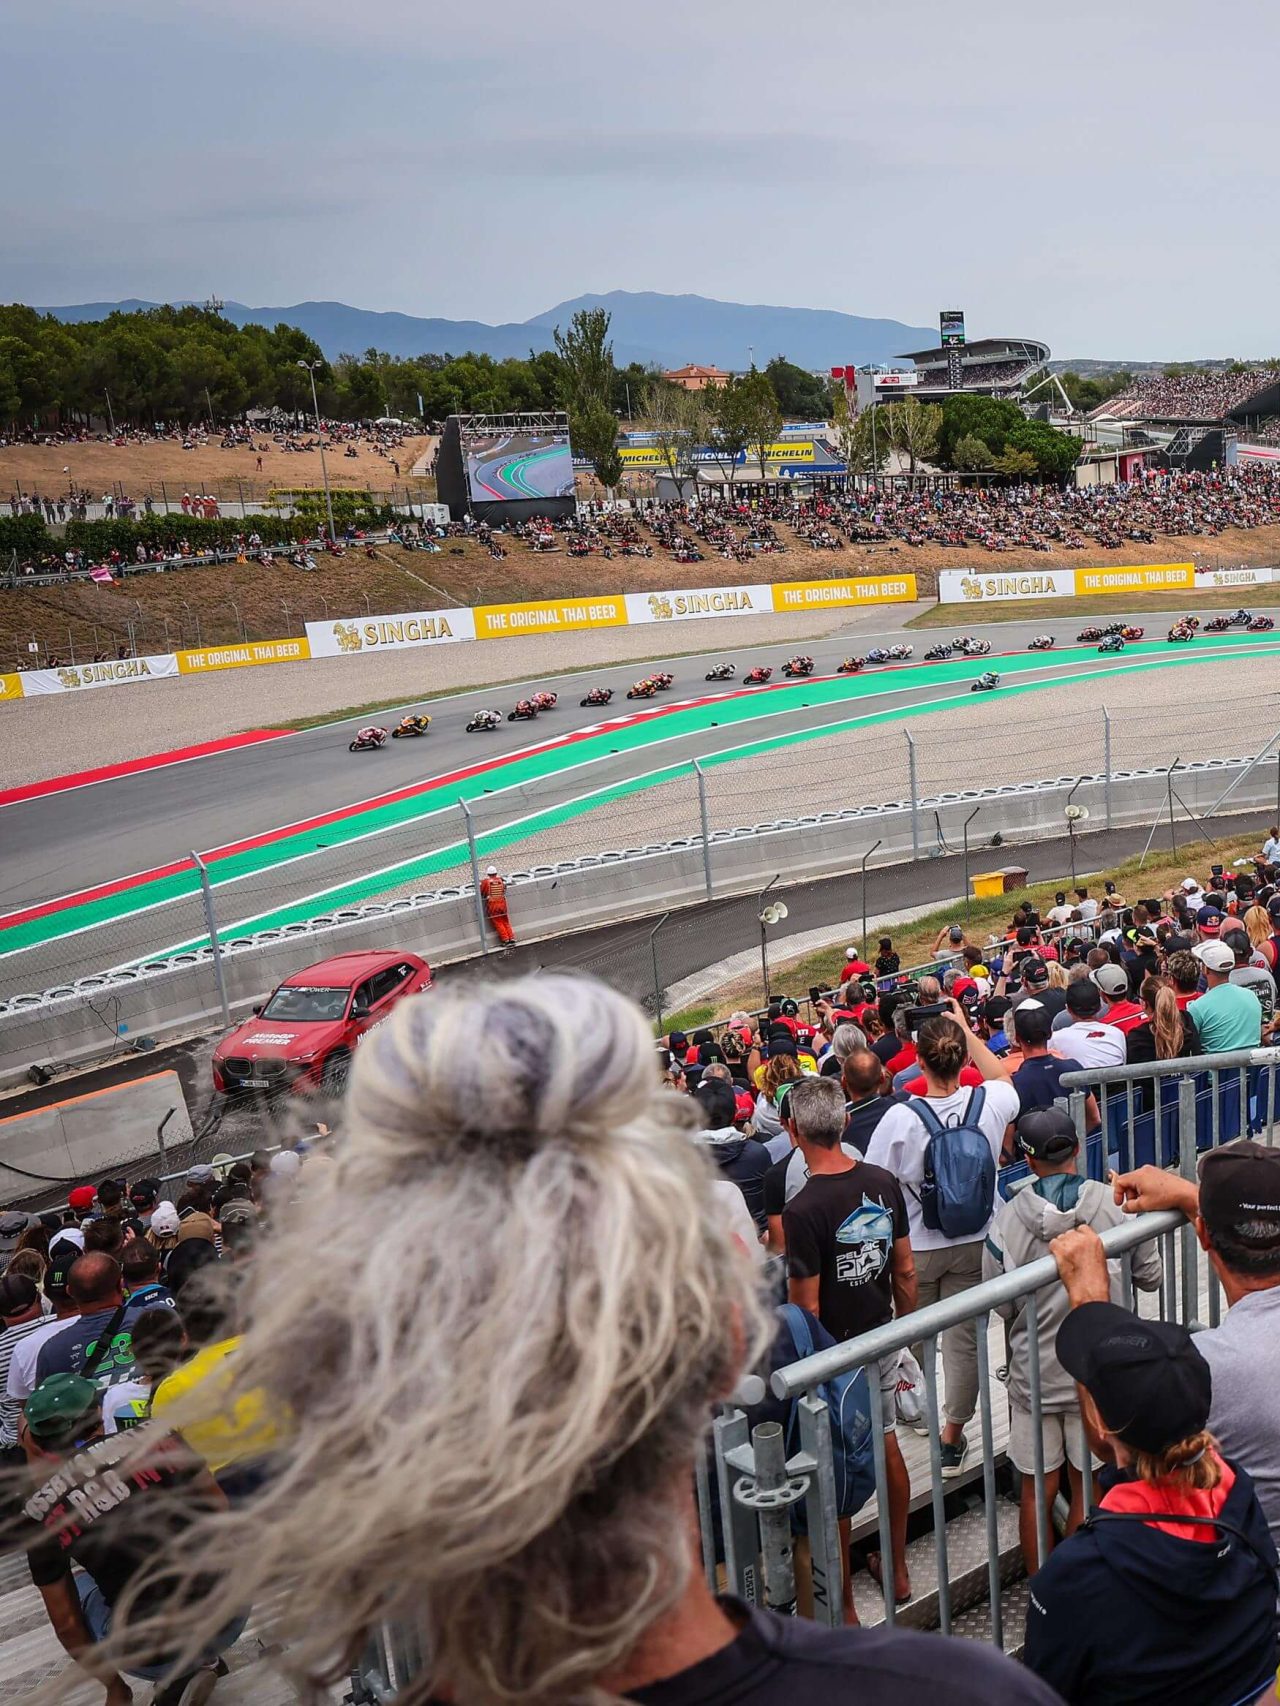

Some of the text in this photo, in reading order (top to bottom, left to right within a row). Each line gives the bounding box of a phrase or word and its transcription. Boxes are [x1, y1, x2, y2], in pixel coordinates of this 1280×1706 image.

[985, 577, 1056, 595] SINGHA
[1083, 570, 1188, 588] THE ORIGINAL THAI BEER
[1223, 571, 1258, 584] SINGHA
[675, 590, 754, 615] SINGHA
[783, 582, 907, 604] THE ORIGINAL THAI BEER
[485, 604, 616, 630] THE ORIGINAL THAI BEER
[364, 616, 454, 646] SINGHA
[186, 643, 301, 668] THE ORIGINAL THAI BEER
[82, 659, 152, 684] SINGHA
